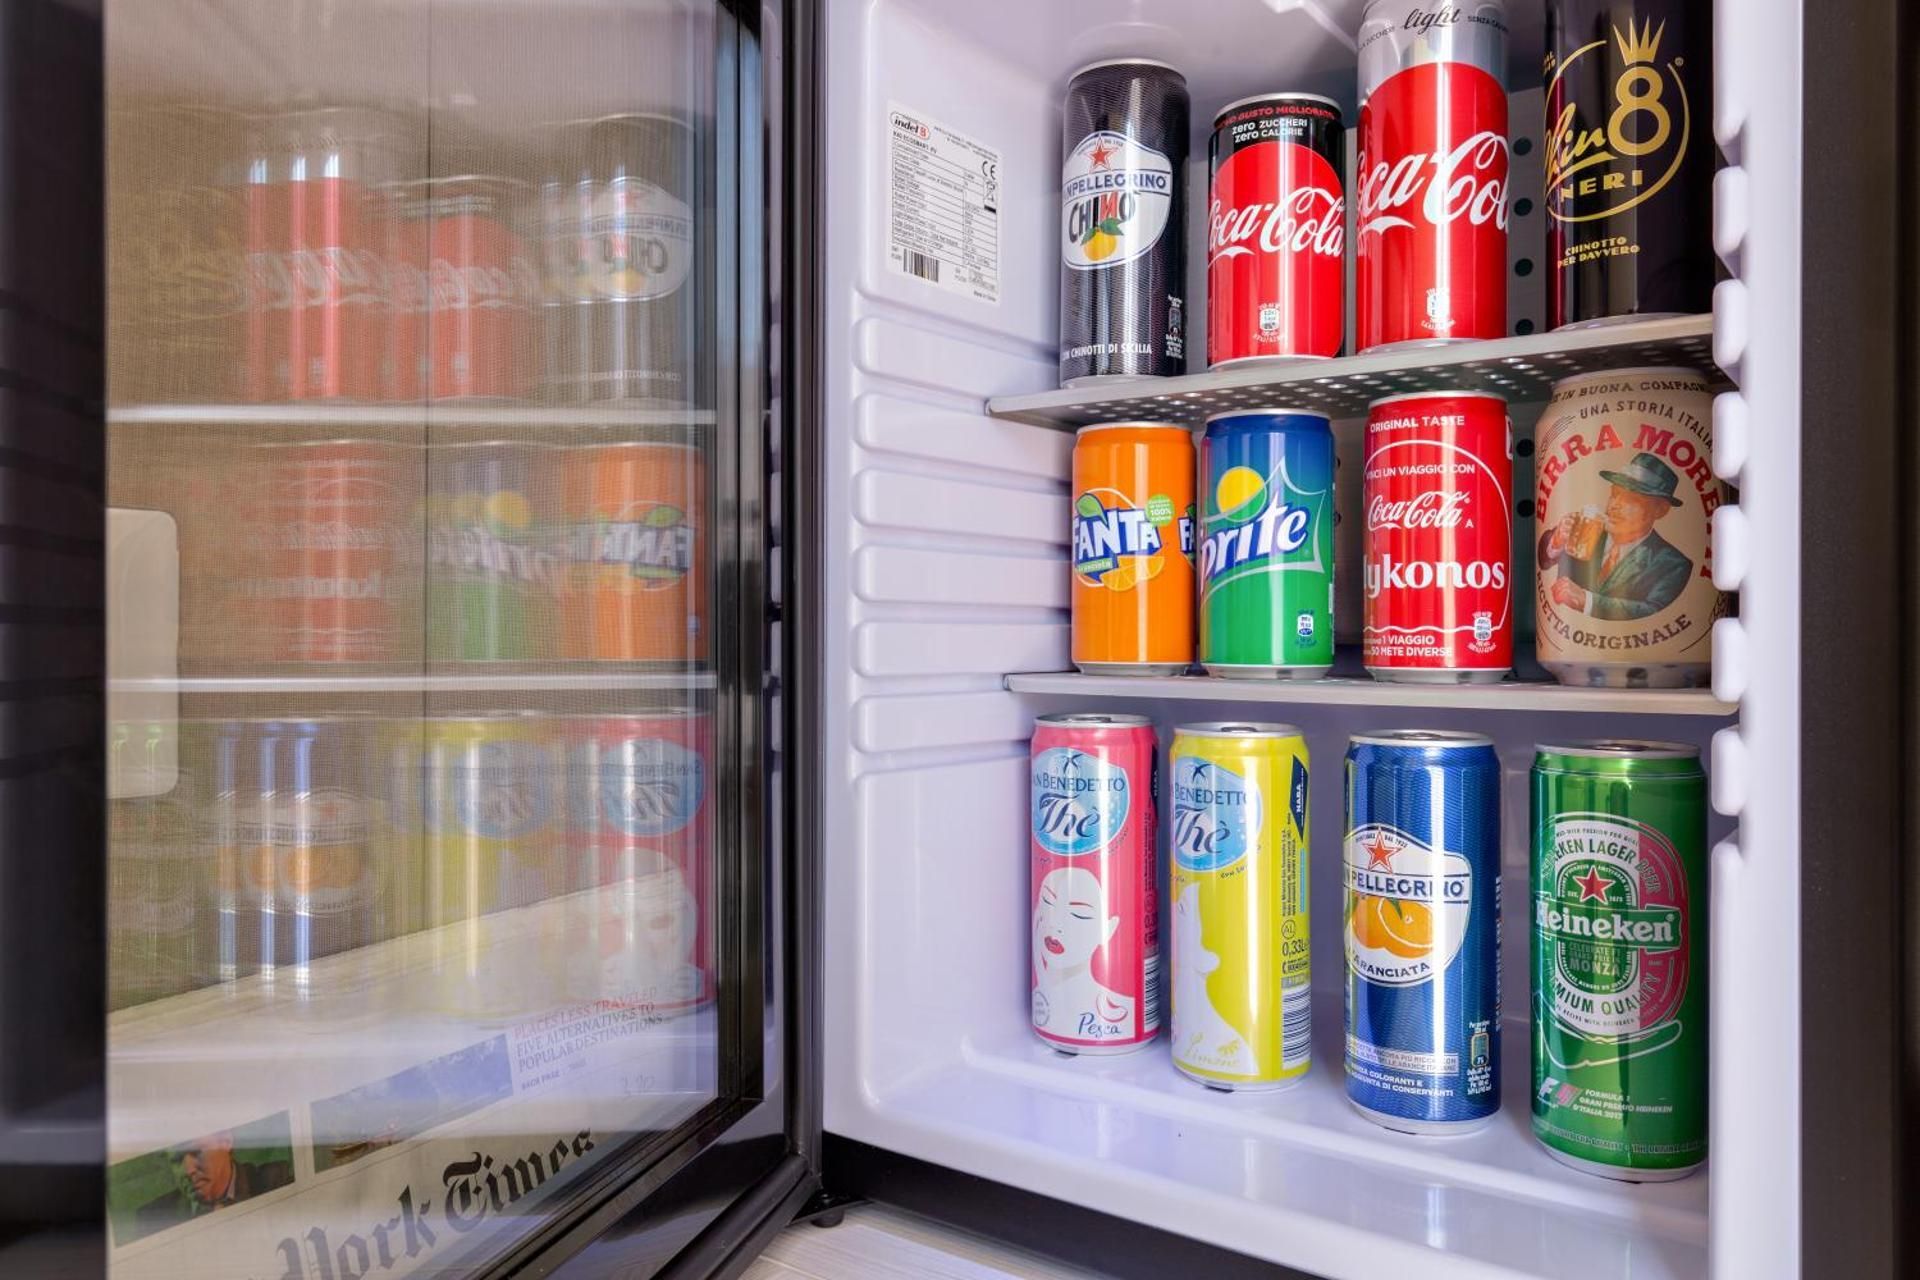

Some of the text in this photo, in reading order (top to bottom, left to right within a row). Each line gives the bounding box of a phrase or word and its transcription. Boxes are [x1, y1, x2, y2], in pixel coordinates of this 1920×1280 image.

[1403, 8, 1461, 35] light
[1238, 107, 1273, 121] GUSTO
[893, 116, 919, 134] indel
[1232, 121, 1256, 135] zero
[1259, 118, 1308, 129] ZUCCHERI
[1235, 127, 1303, 143] zero CALORIE
[1561, 170, 1643, 203] NERI
[1565, 237, 1627, 256] CHINOTTO
[1558, 245, 1640, 269] PER DAVVERO
[1109, 344, 1118, 354] DI
[1122, 344, 1152, 354] SICILIA
[1579, 382, 1634, 397] BUONA
[1580, 404, 1610, 419] UNA
[1616, 401, 1674, 419] STORIA
[1370, 415, 1465, 433] ORIGINAL TASTE
[1383, 467, 1396, 476] UN
[1399, 464, 1446, 475] VIAGGIO
[1451, 464, 1475, 474] CON
[1536, 423, 1624, 523] BIRRA
[1368, 491, 1470, 531] Coca-Cola
[1073, 509, 1161, 562] FANTA
[1200, 491, 1307, 598] prite
[1388, 635, 1435, 645] VIAGGIO
[1572, 614, 1692, 649] ORIGINALE
[1380, 647, 1403, 656] METE
[1406, 647, 1453, 657] DIVERSE
[1589, 839, 1637, 864] LAGER
[1536, 899, 1674, 942] Heineken
[1569, 957, 1620, 975] MONZA
[1601, 972, 1660, 1015] QUALITY
[517, 1002, 656, 1058] FIVE ALTERNATIVES TO
[519, 1014, 664, 1073] POPULAR DESTINATIONS
[1369, 1071, 1415, 1086] COLORANTI
[1382, 1083, 1391, 1091] DI
[1392, 1085, 1454, 1098] CONSERVANTI
[1585, 1089, 1624, 1101] FORMULA
[1579, 1096, 1673, 1113] GRAN PREMIO HEINEKEN
[276, 1128, 595, 1280] York Times
